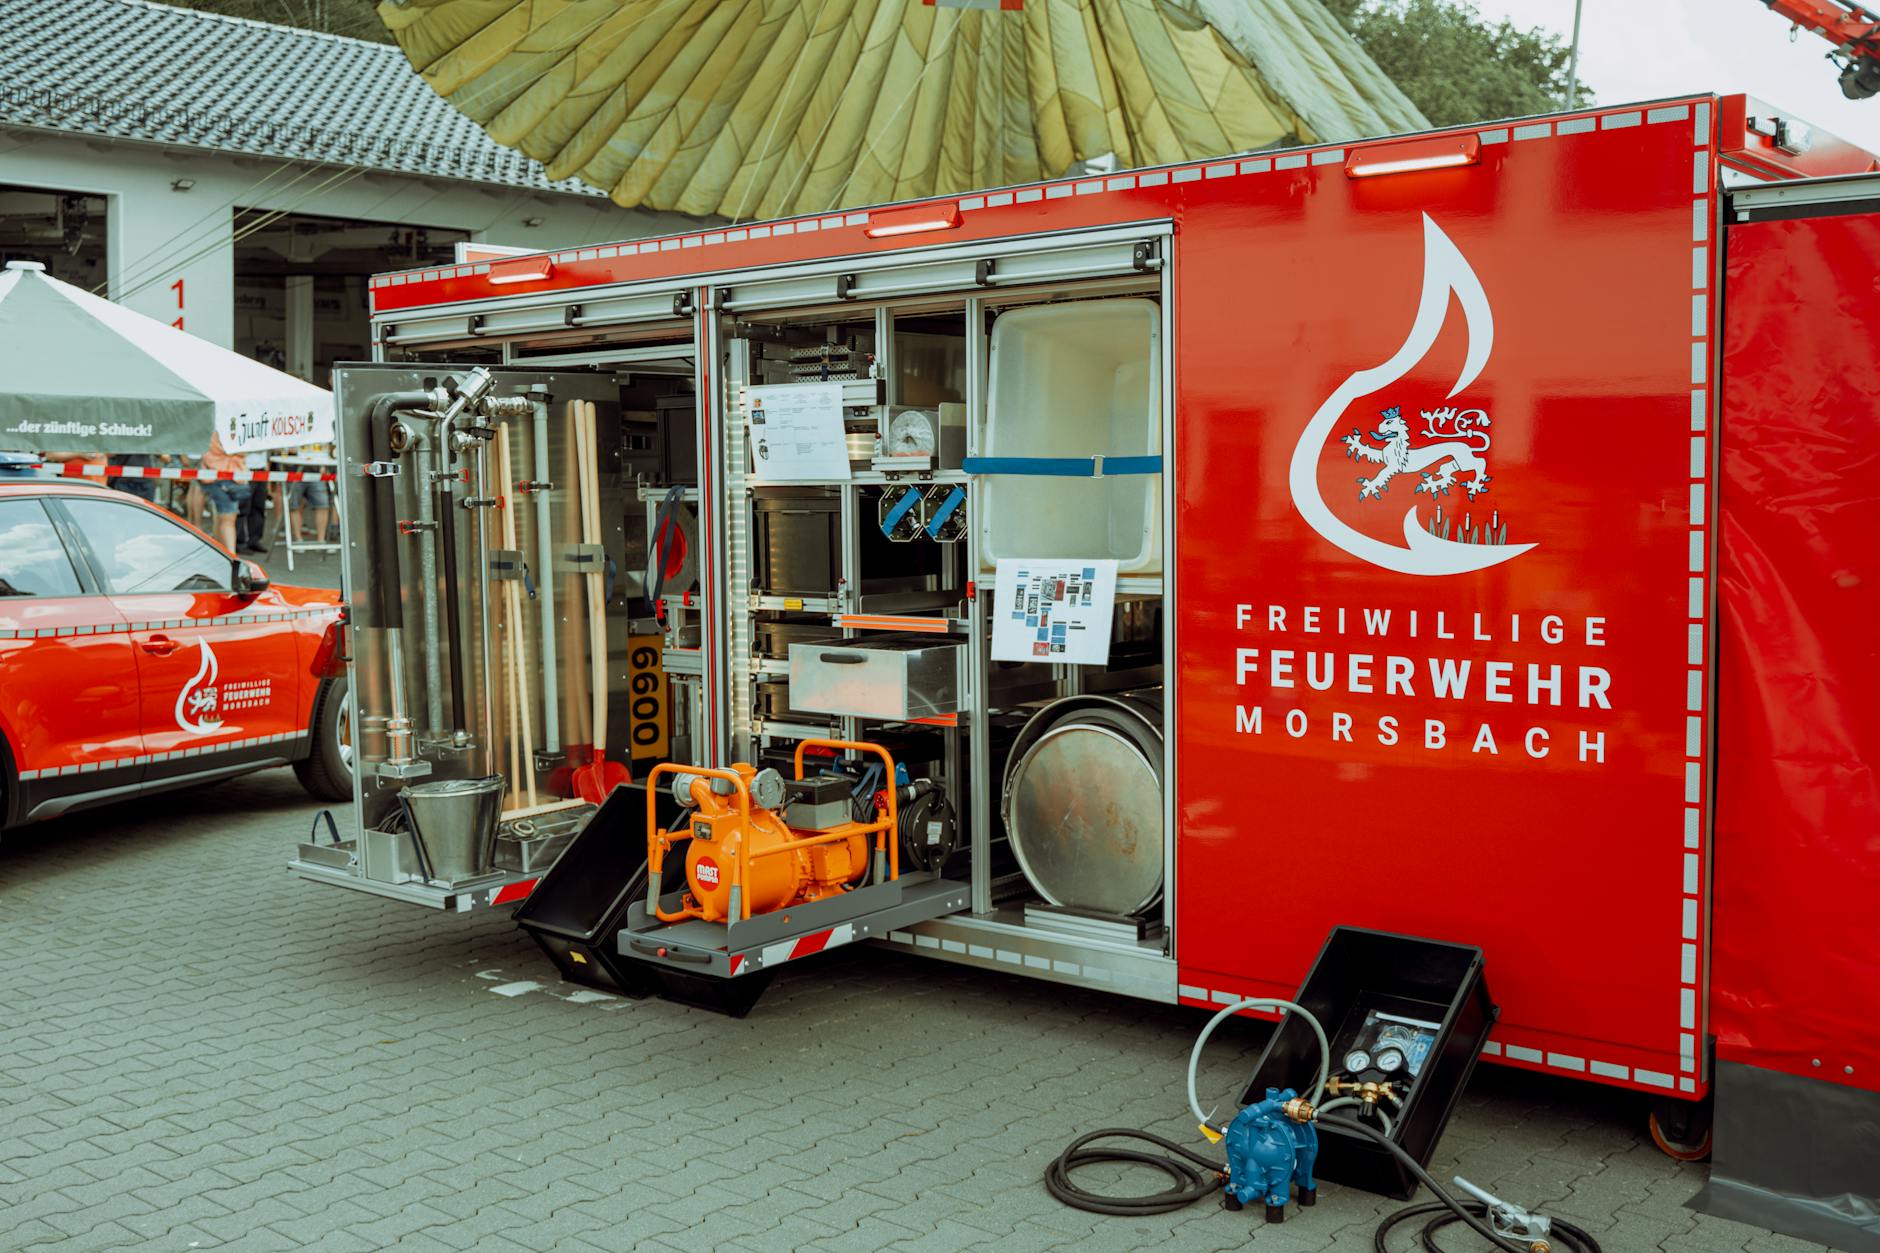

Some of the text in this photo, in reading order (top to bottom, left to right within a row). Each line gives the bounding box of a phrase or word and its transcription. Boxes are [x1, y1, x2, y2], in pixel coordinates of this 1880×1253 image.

[43, 420, 97, 437] zünftige
[99, 422, 152, 437] Schluck!
[1236, 603, 1606, 646] FREIWILLIGE
[223, 687, 271, 702] FEUERWEHR
[1236, 647, 1612, 710] FEUERWEHR
[1236, 704, 1606, 764] MORSBACH
